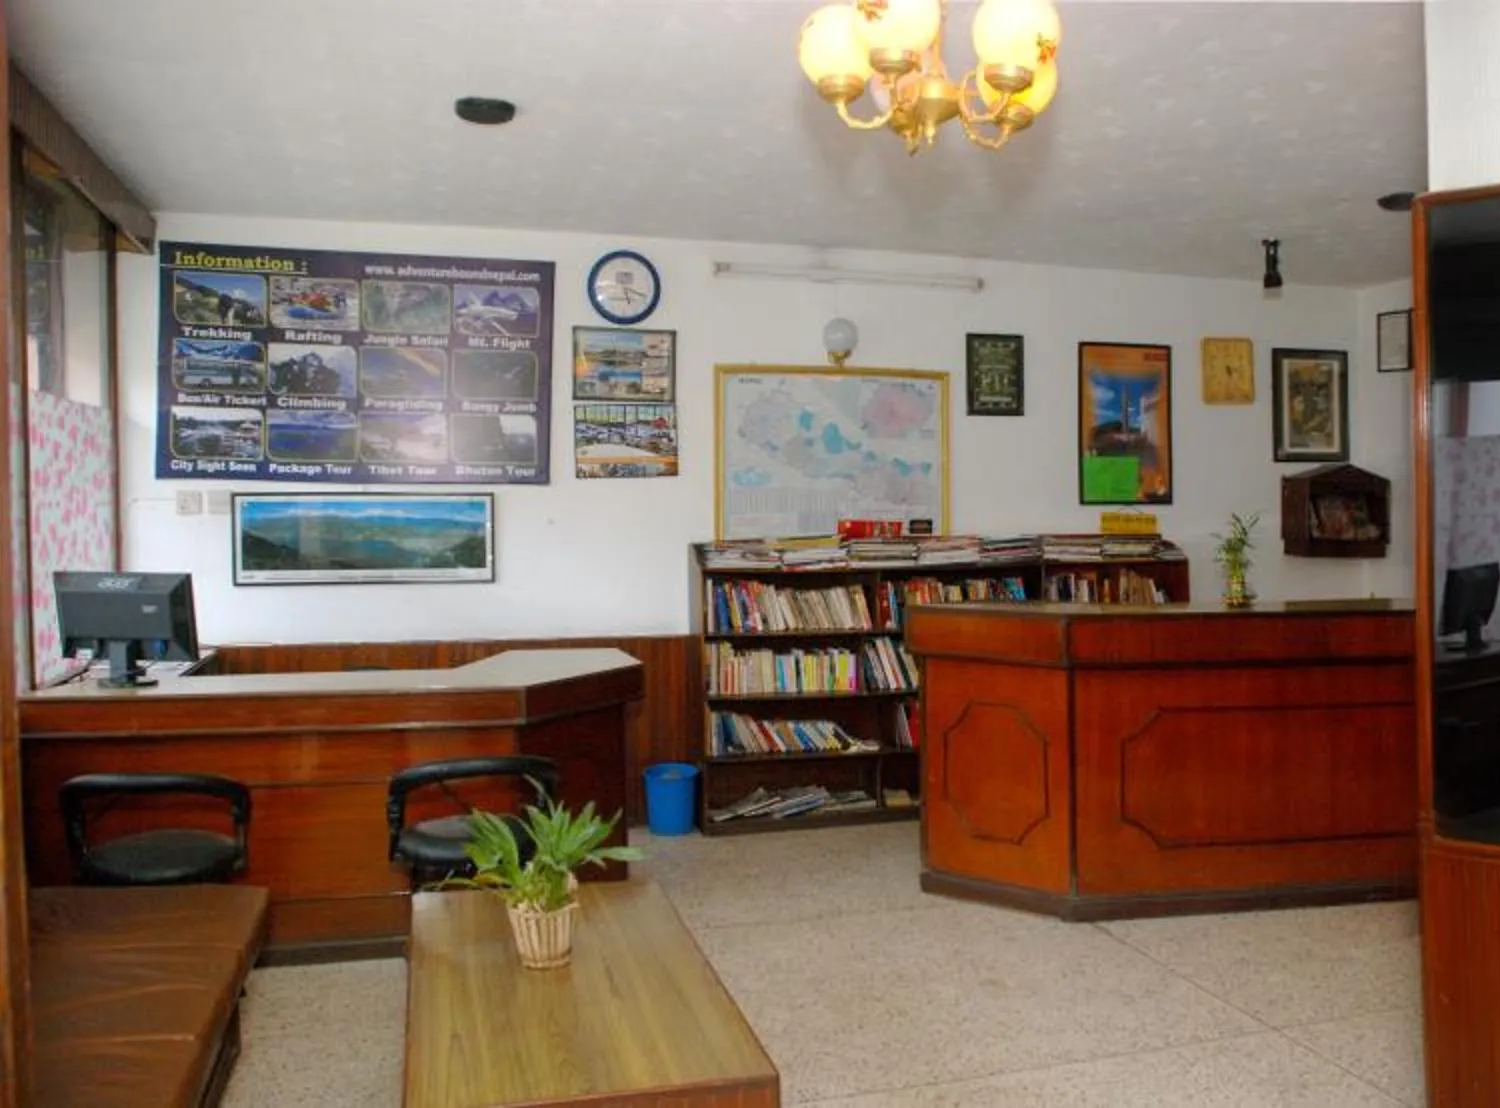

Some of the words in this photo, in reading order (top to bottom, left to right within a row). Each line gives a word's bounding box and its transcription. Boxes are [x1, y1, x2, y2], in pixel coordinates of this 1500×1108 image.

[175, 252, 294, 271] Information
[183, 327, 252, 340] Trekking
[284, 330, 342, 345] Rafting
[363, 334, 408, 347] Jungle
[411, 335, 448, 346] Safari
[468, 337, 489, 348] Mt.
[493, 338, 531, 350] Flight
[277, 397, 347, 411] Climbing
[170, 460, 194, 472] City
[196, 460, 225, 473] Sight
[269, 463, 322, 475] Package
[326, 464, 352, 475] Tour
[369, 465, 403, 475] Tibet
[408, 465, 437, 475] Tour
[455, 466, 502, 476] Bhutan
[507, 467, 536, 477] Tour
